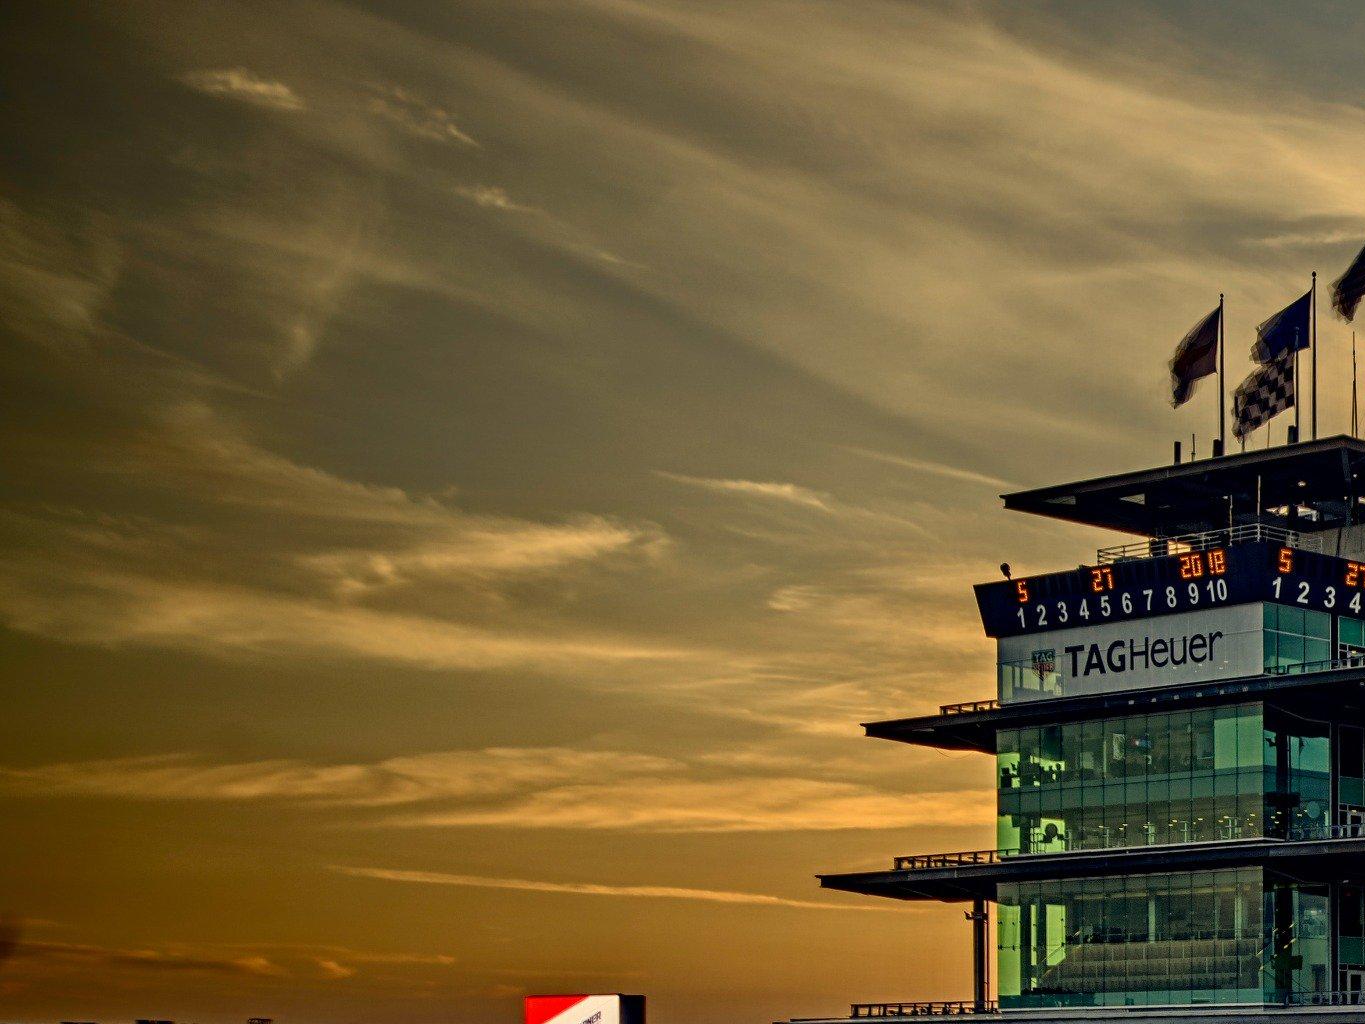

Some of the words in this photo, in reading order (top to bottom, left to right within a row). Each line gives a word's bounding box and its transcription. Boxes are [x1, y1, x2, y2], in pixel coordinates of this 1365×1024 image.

[1278, 548, 1292, 573] 5
[1016, 580, 1029, 602] 5
[1091, 568, 1114, 592] 27
[1017, 607, 1026, 628] 1
[1036, 604, 1048, 626] 2
[1057, 601, 1069, 623] 3
[1079, 599, 1090, 620] 4
[1100, 595, 1111, 617] 5
[1121, 592, 1133, 613] 6
[1142, 589, 1153, 610] 7
[1166, 586, 1177, 608] 8
[1188, 582, 1199, 605] 9
[1206, 578, 1228, 602] 10
[1271, 576, 1282, 599] 1
[1297, 581, 1309, 604] 2
[1323, 586, 1336, 609] 3
[1348, 591, 1361, 614] 4
